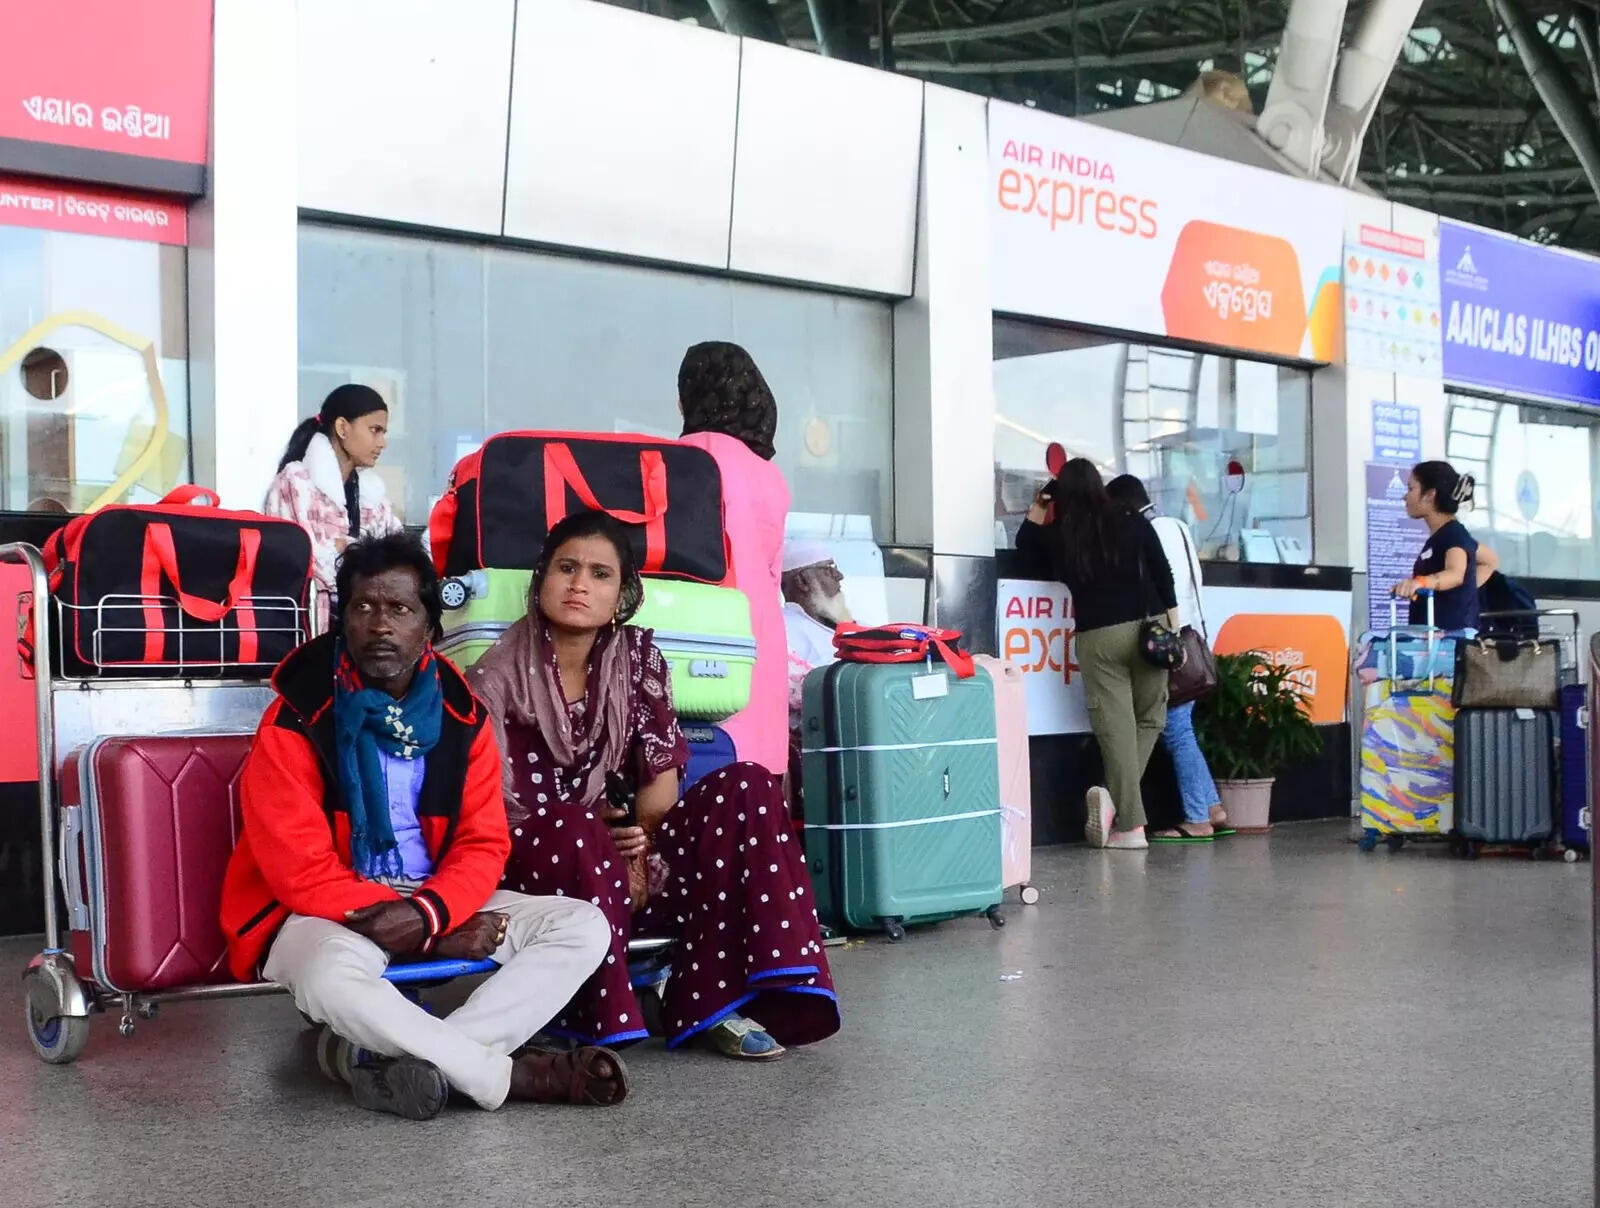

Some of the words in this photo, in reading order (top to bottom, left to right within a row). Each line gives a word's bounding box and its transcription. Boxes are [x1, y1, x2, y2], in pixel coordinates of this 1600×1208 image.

[1003, 139, 1043, 167] AIR
[1051, 151, 1116, 183] INDIA
[998, 167, 1159, 240] express
[1446, 301, 1527, 356] AAICLAS
[1530, 318, 1583, 368] ILHBS
[1006, 596, 1053, 619] AIR
